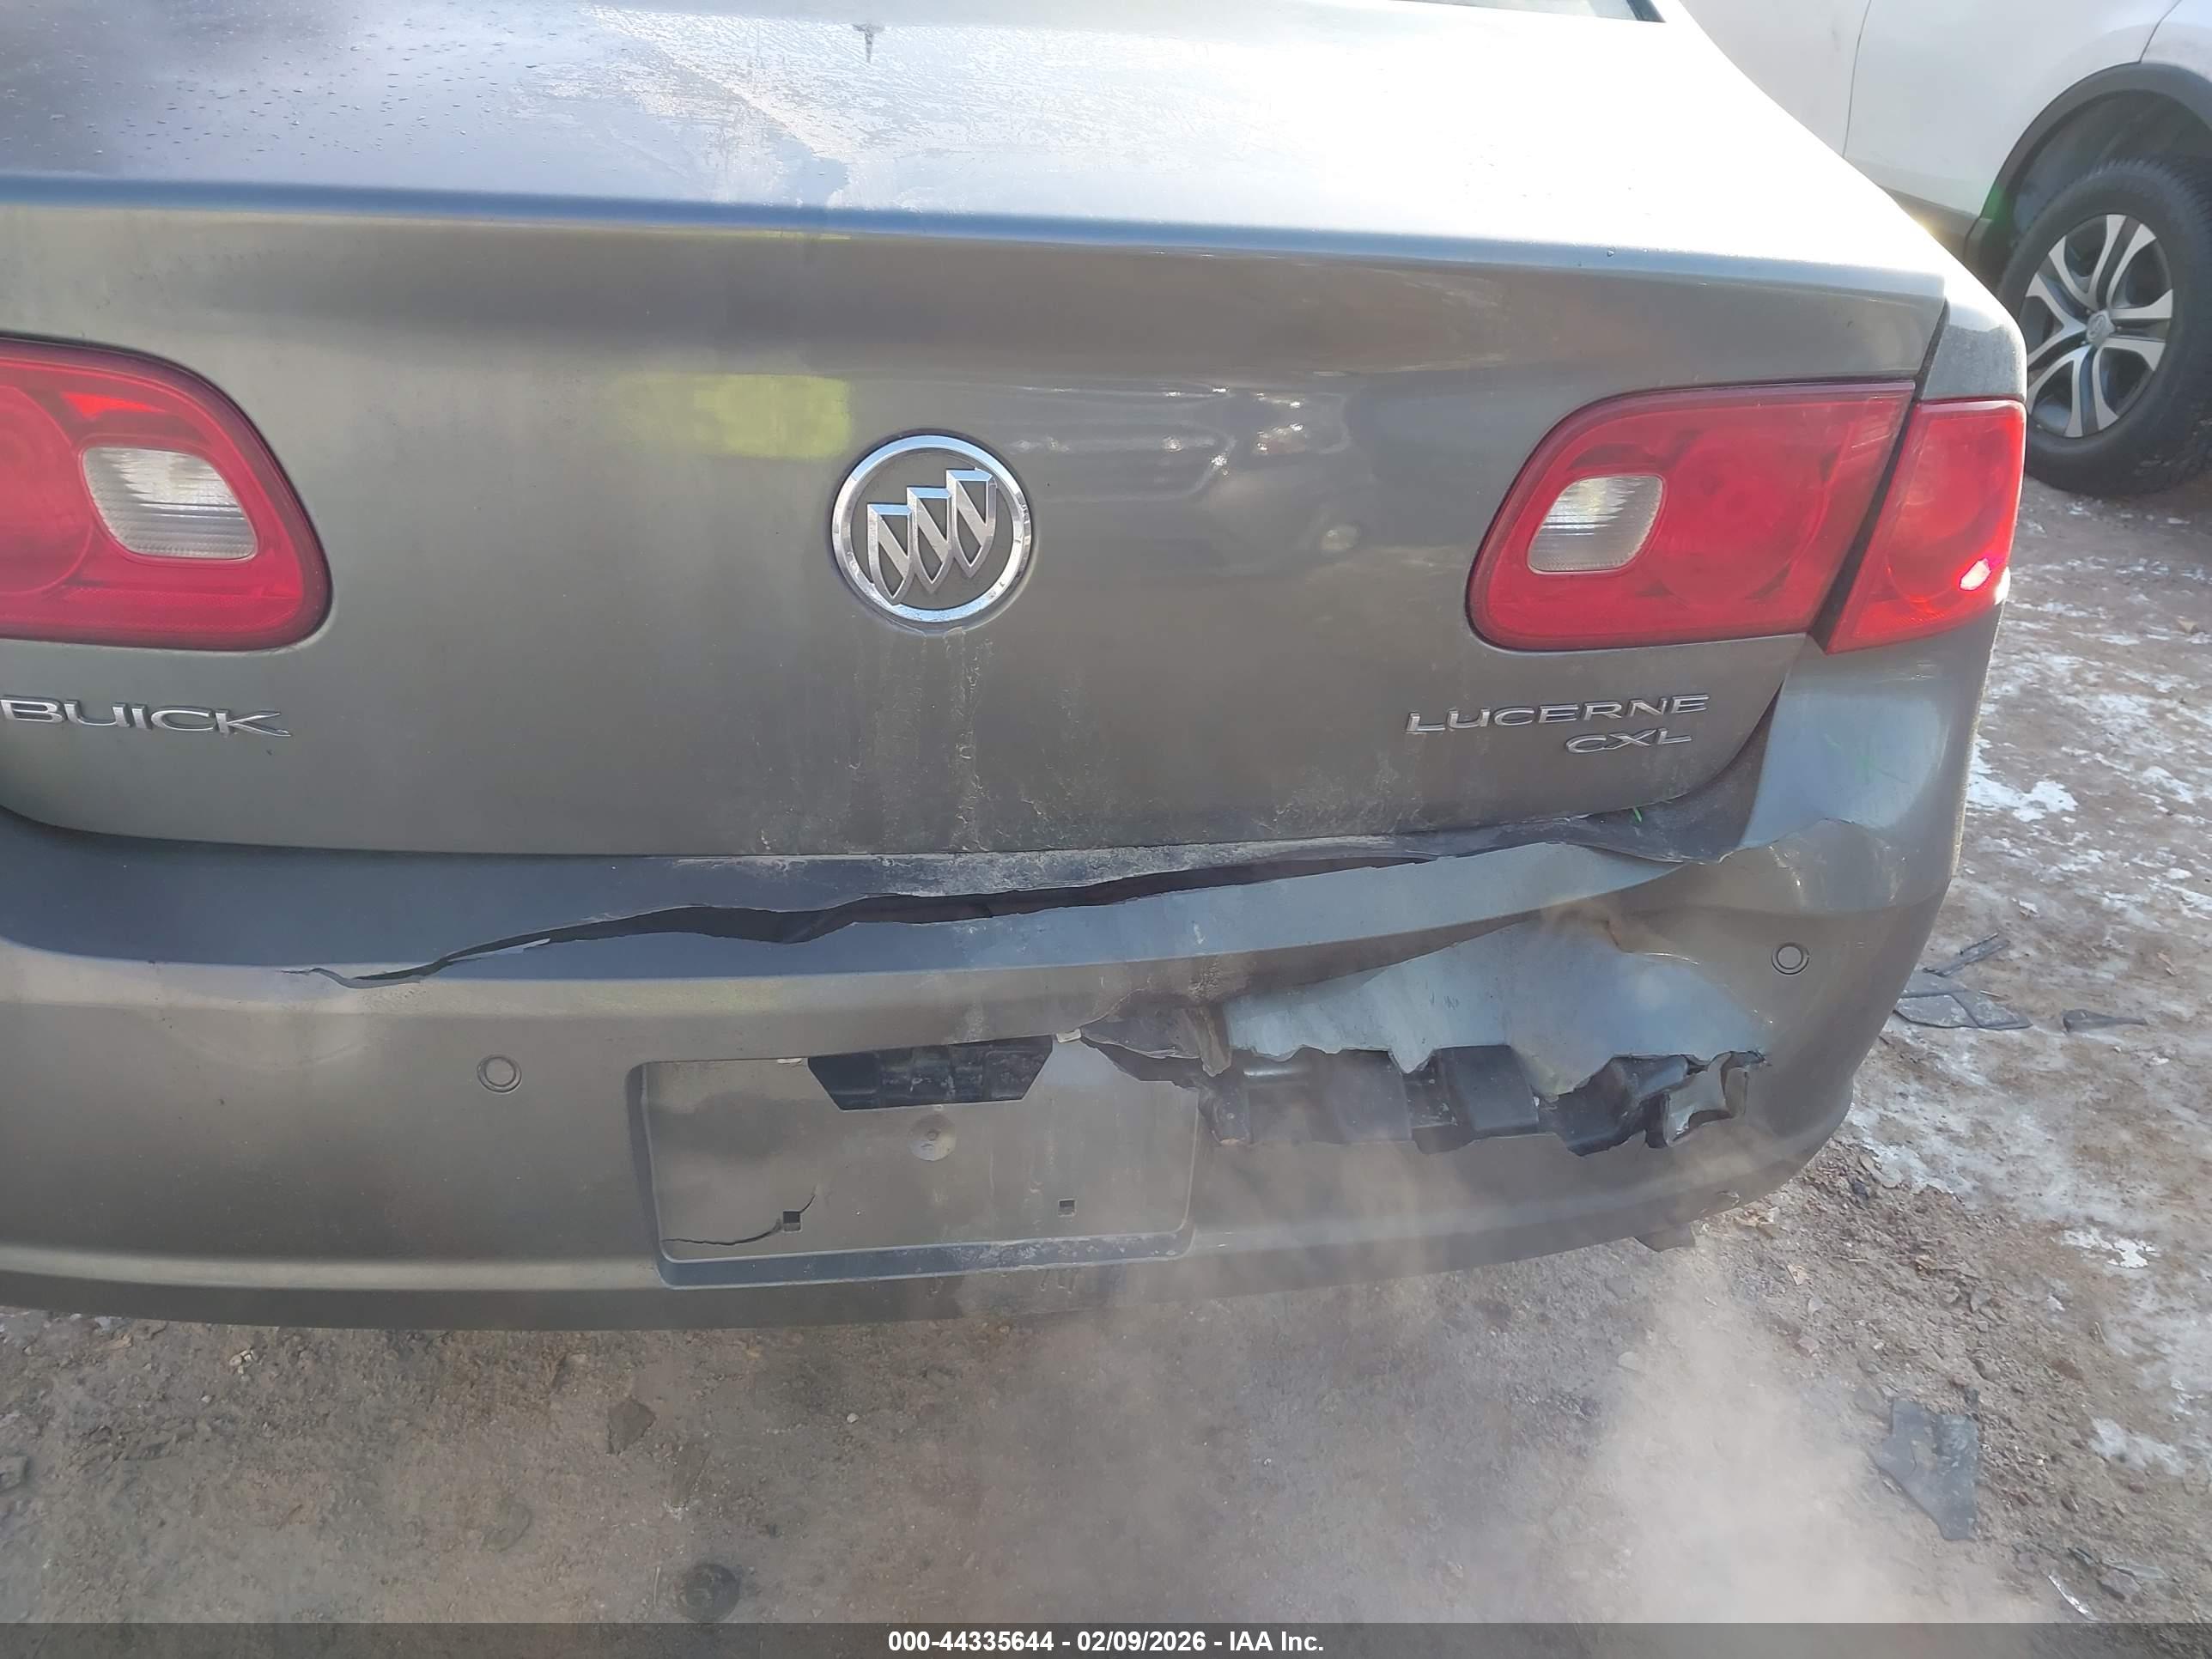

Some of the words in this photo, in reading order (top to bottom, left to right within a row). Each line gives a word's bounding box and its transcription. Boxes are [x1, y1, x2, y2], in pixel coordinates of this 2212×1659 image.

[0, 695, 292, 738] BUICK
[1405, 693, 1710, 732] LUCERNE
[1565, 727, 1692, 754] CXL
